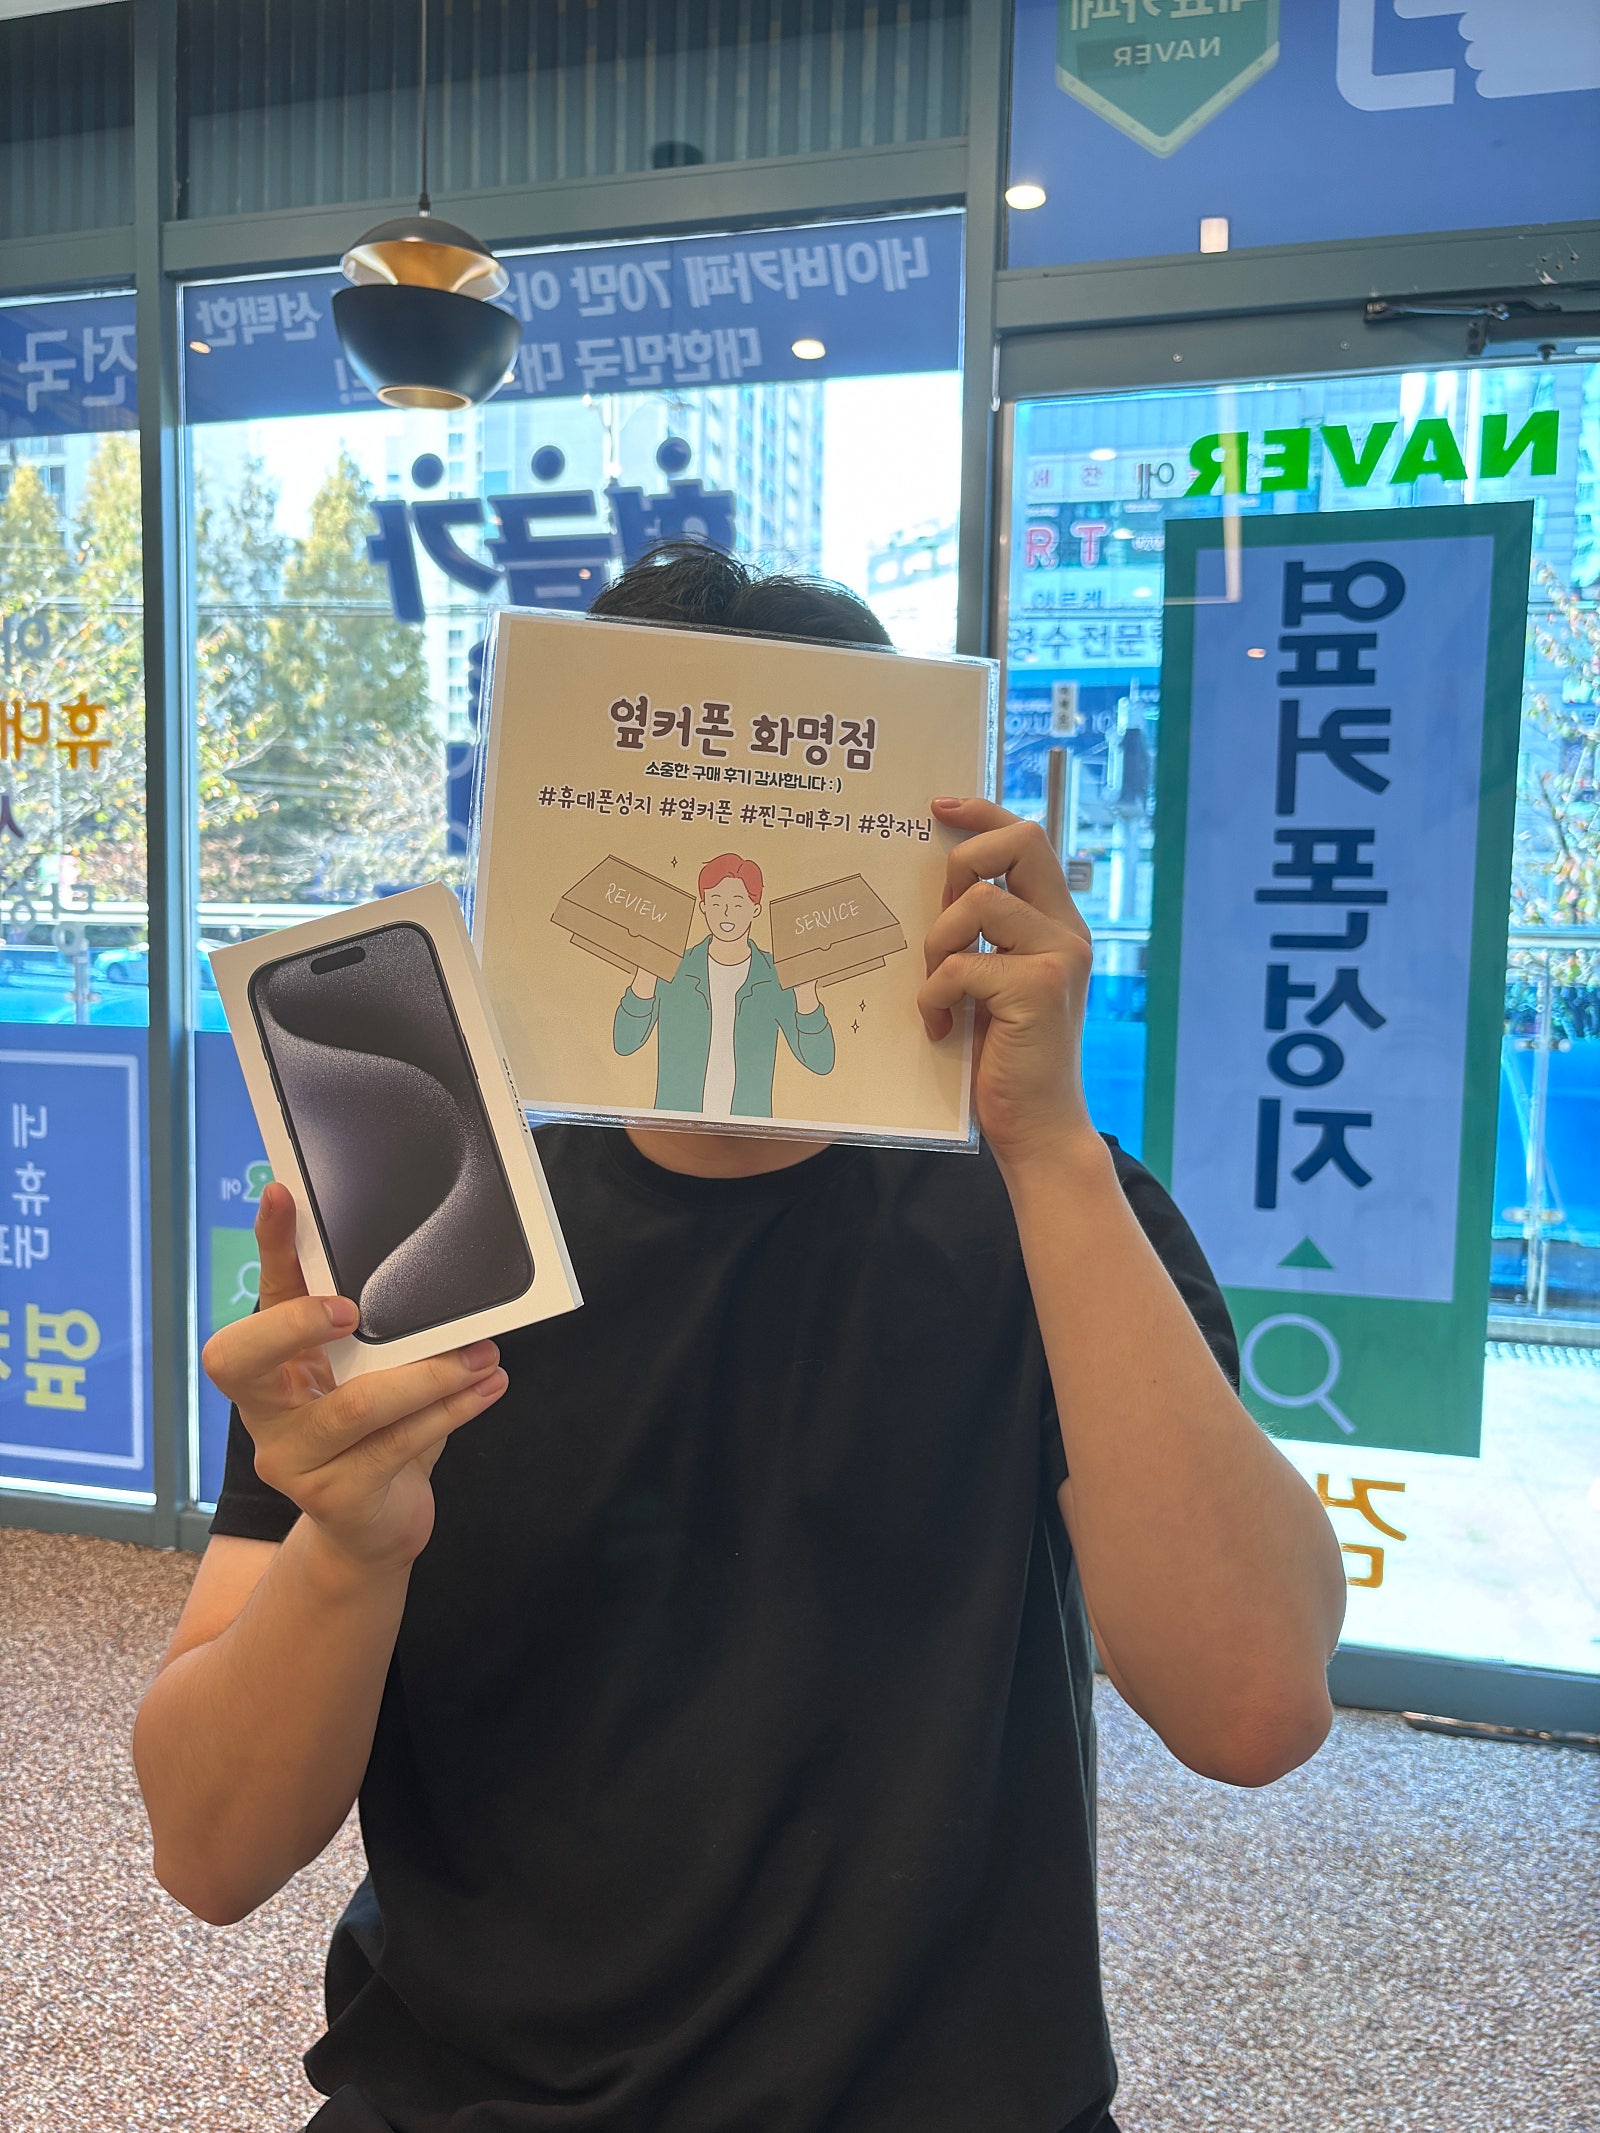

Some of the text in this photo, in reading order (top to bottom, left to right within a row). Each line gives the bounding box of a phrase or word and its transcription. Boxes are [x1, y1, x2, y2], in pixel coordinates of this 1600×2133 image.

[610, 695, 876, 771] 옆커폰 화명점
[645, 761, 689, 780] 소중한
[692, 765, 721, 782] 구매
[723, 767, 752, 785] 후기
[754, 770, 827, 792] 감사합니다
[538, 785, 932, 842] #휴대폰성지 #옆커폰 #찐구매후기 #왕자님
[605, 882, 667, 923] REVIEW
[795, 900, 860, 935] SERVICE
